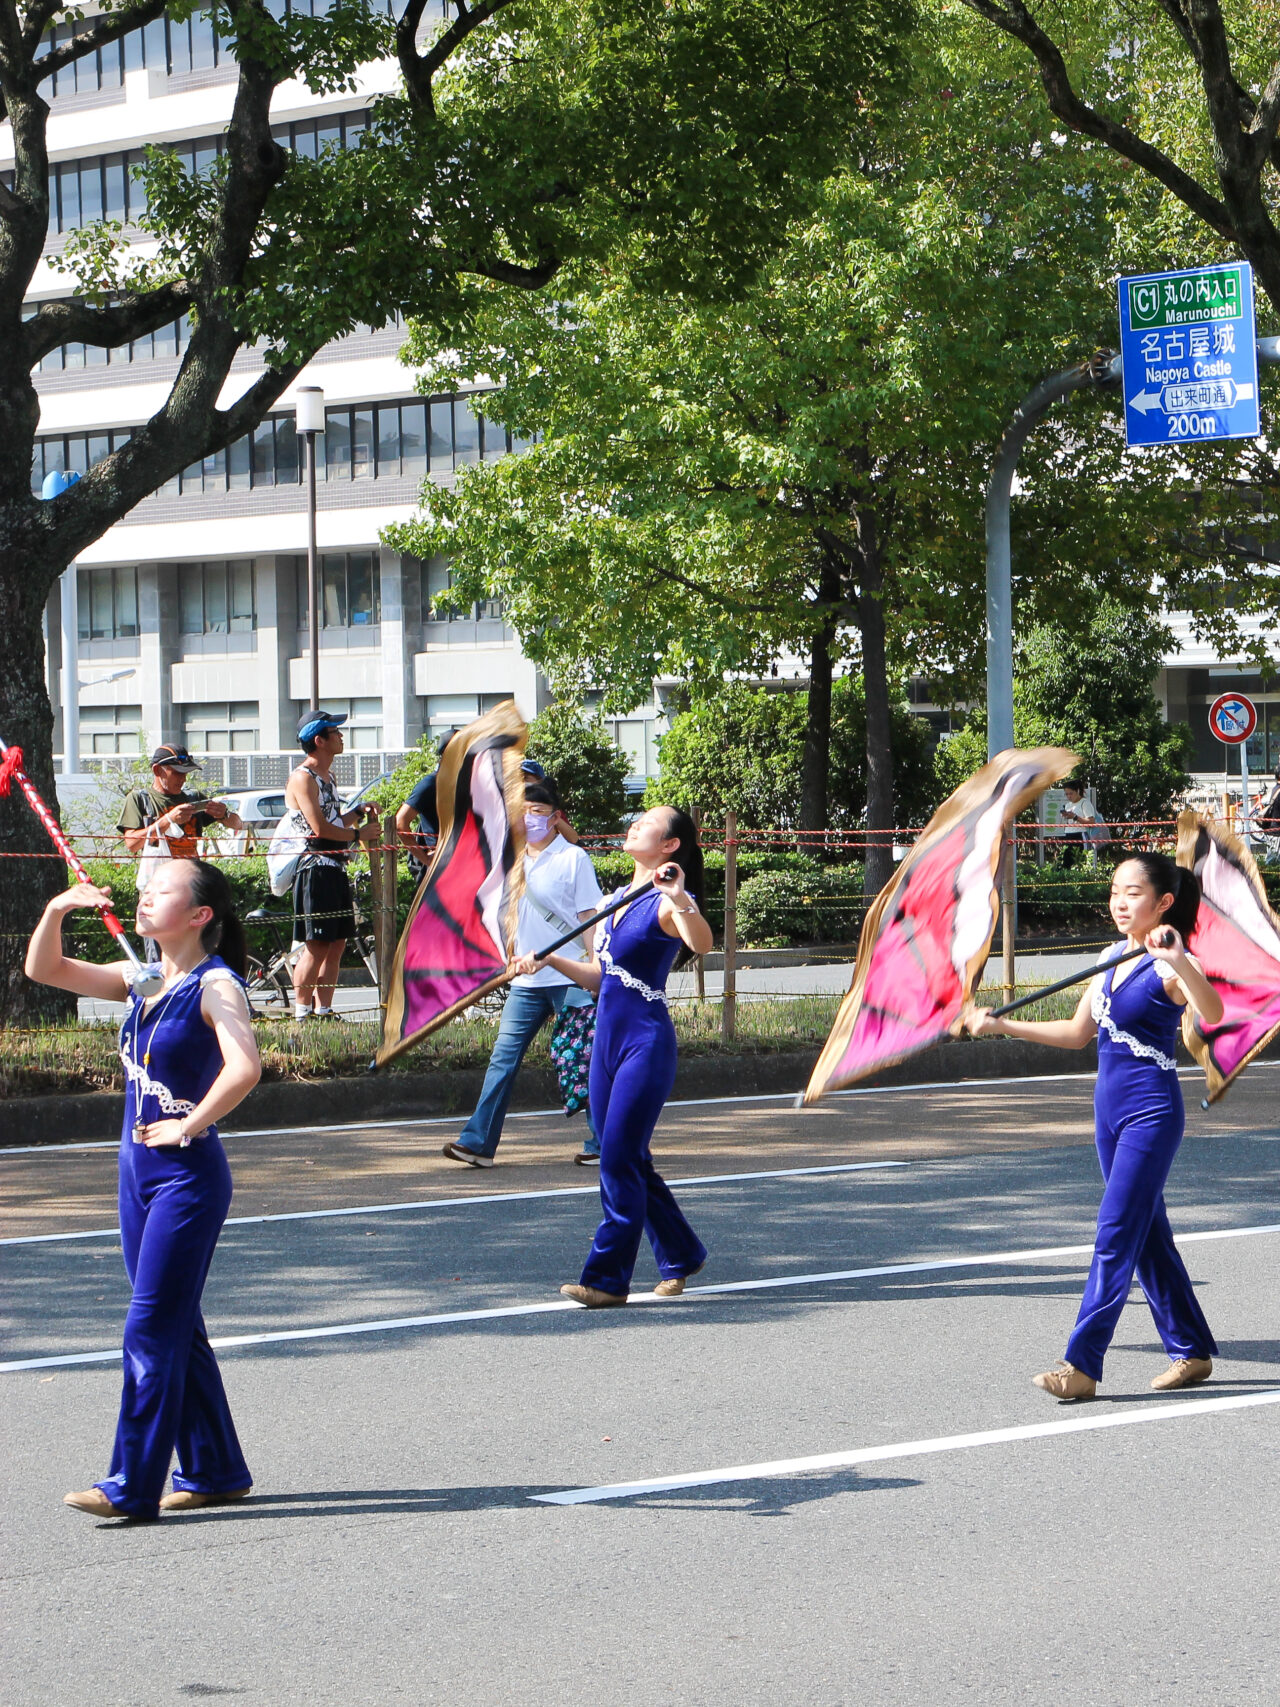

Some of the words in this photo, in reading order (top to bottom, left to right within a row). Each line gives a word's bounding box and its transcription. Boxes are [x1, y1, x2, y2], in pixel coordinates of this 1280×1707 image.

[1137, 287, 1157, 313] C1
[1164, 276, 1237, 306] 丸の内入口
[1165, 302, 1237, 324] Marunouchi
[1140, 323, 1236, 363] 名古屋城
[1145, 367, 1190, 385] Nagoya
[1193, 360, 1232, 378] Castle
[1170, 385, 1227, 408] 出来町通
[1167, 413, 1216, 438] 200m
